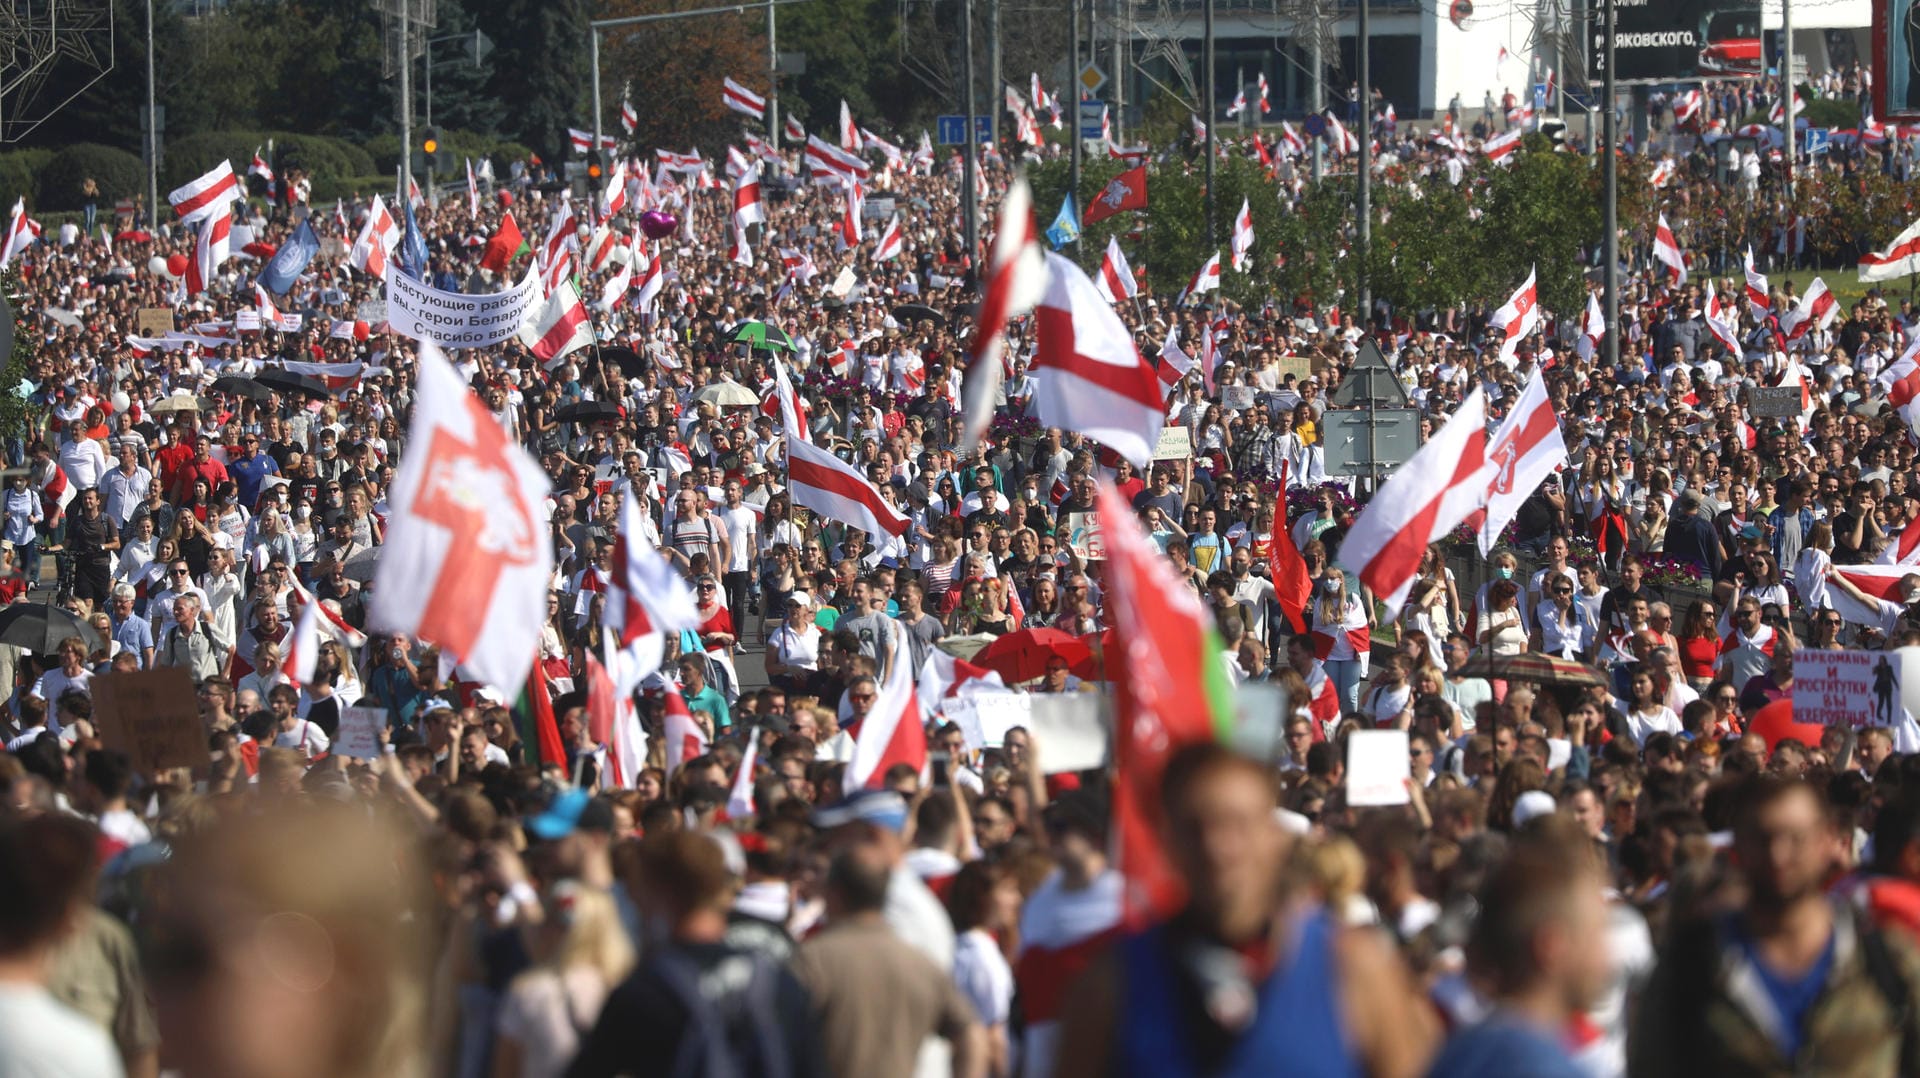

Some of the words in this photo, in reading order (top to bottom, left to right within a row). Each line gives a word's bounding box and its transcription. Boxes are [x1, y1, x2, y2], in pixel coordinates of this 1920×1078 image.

[395, 275, 475, 312] Бастующие
[393, 293, 409, 312] вы
[419, 308, 463, 326] герои
[469, 288, 536, 326] Беларуси!
[414, 322, 483, 343] Спасибо
[489, 320, 520, 339] вам!
[1794, 653, 1871, 666] НАРКОМАНЫ
[1826, 666, 1838, 678] И
[1823, 694, 1847, 708] ВЫ
